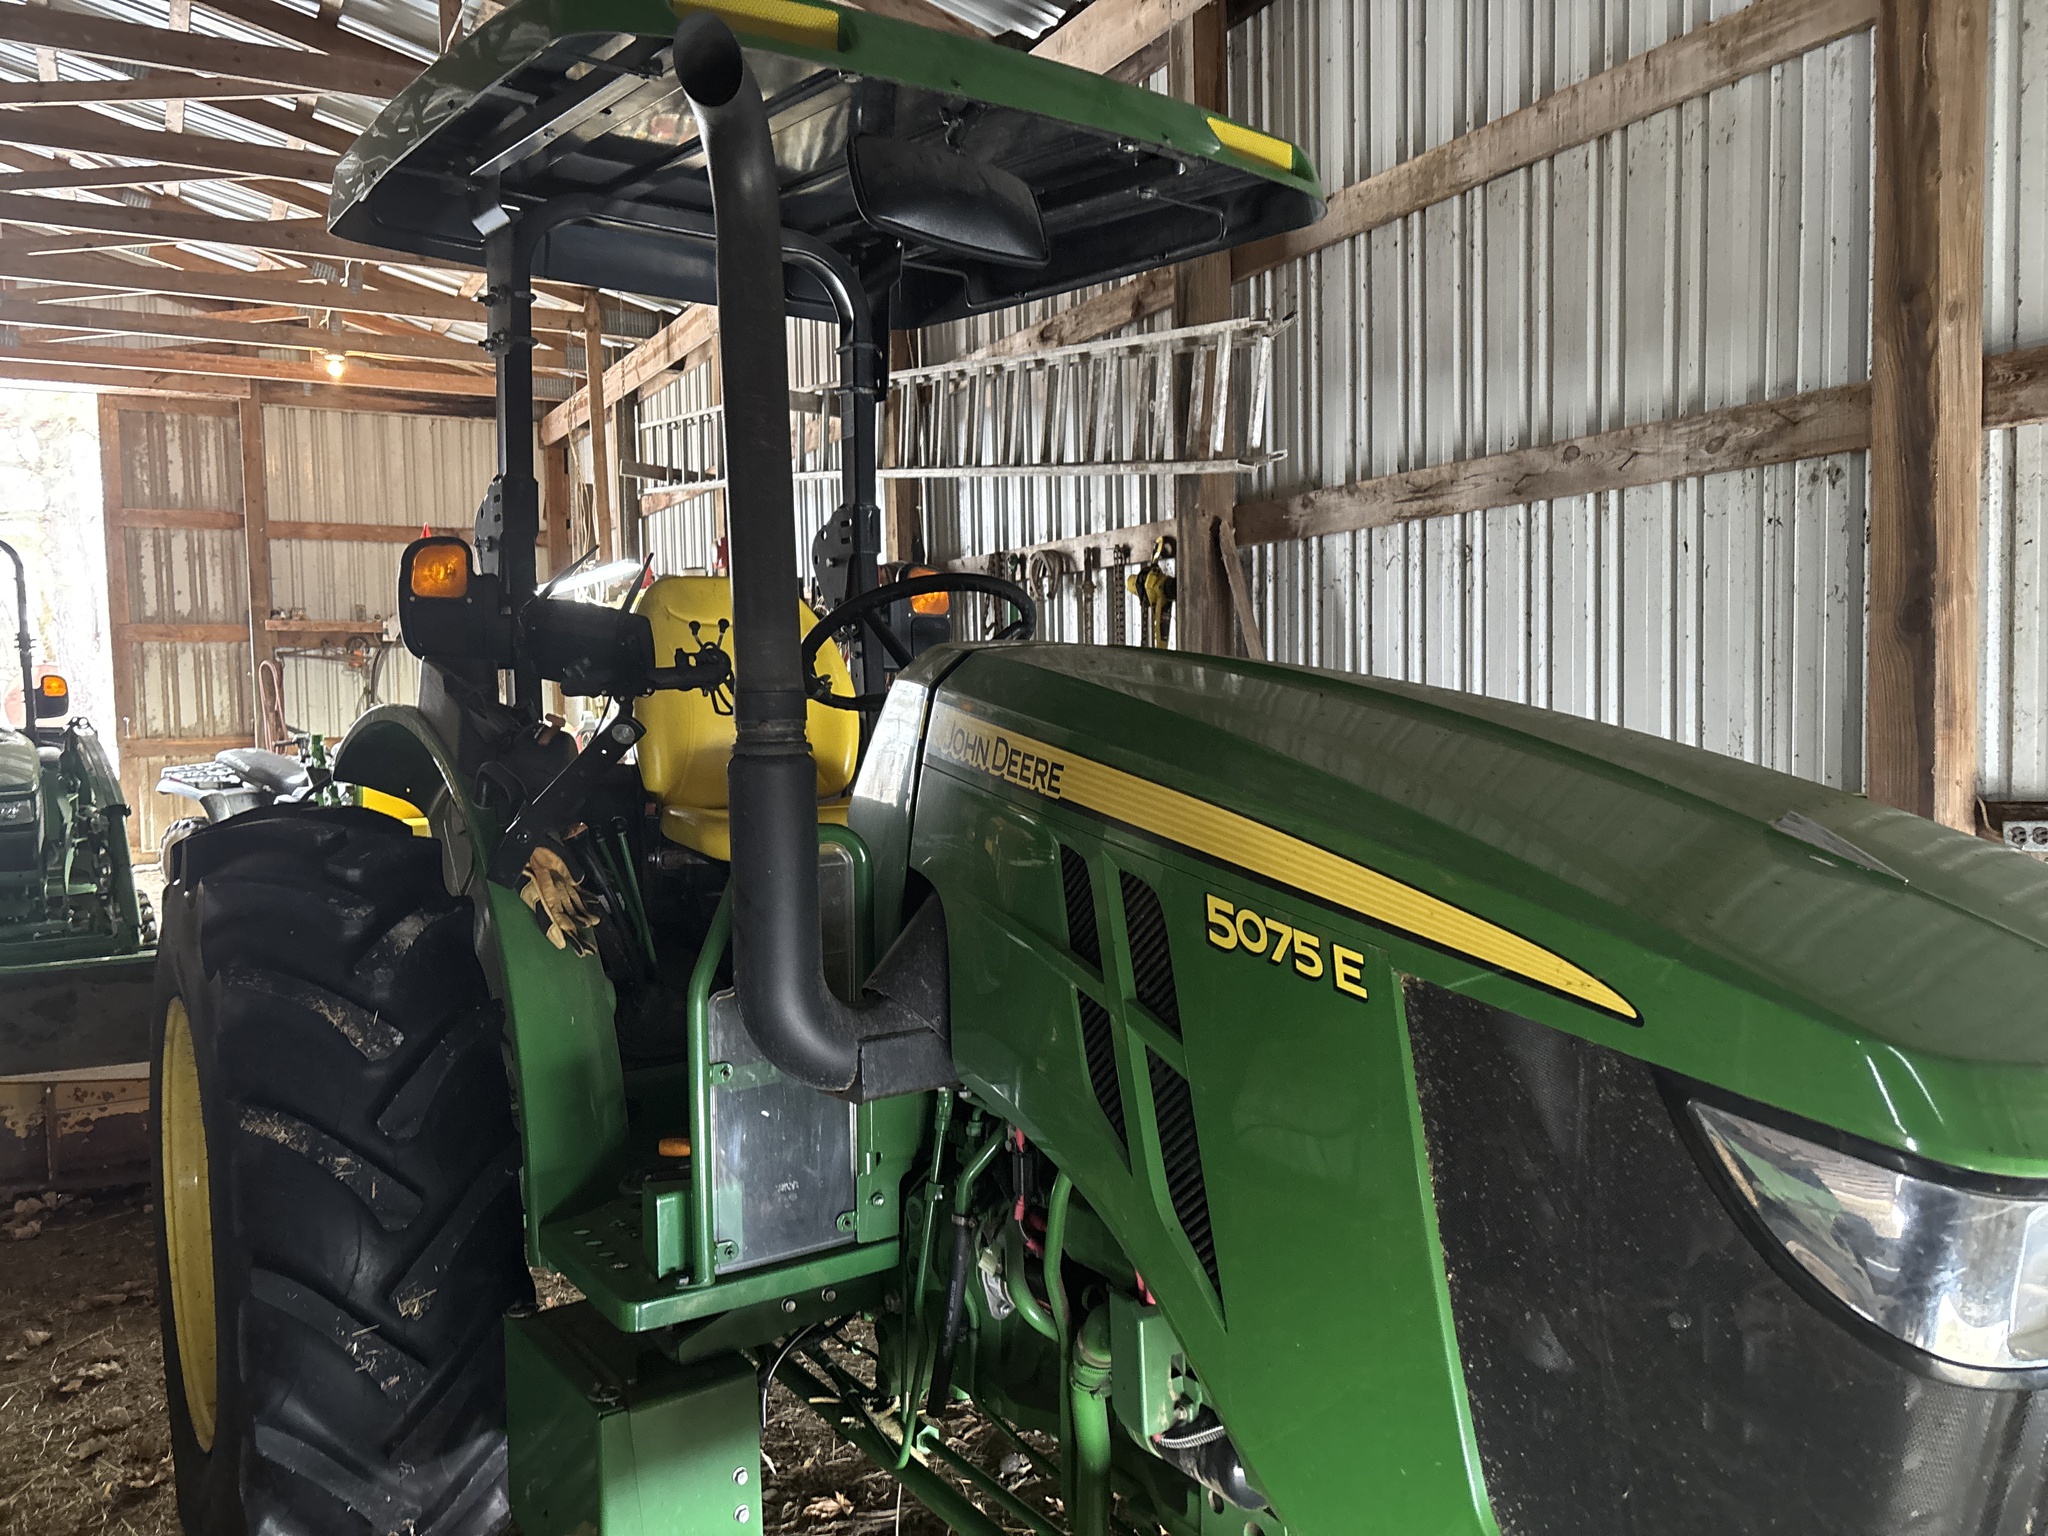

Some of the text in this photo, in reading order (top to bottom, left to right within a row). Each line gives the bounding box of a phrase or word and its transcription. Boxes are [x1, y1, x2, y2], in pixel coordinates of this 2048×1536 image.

[942, 719, 1065, 797] JOHN DEERE
[1205, 892, 1370, 1002] 5075 E
